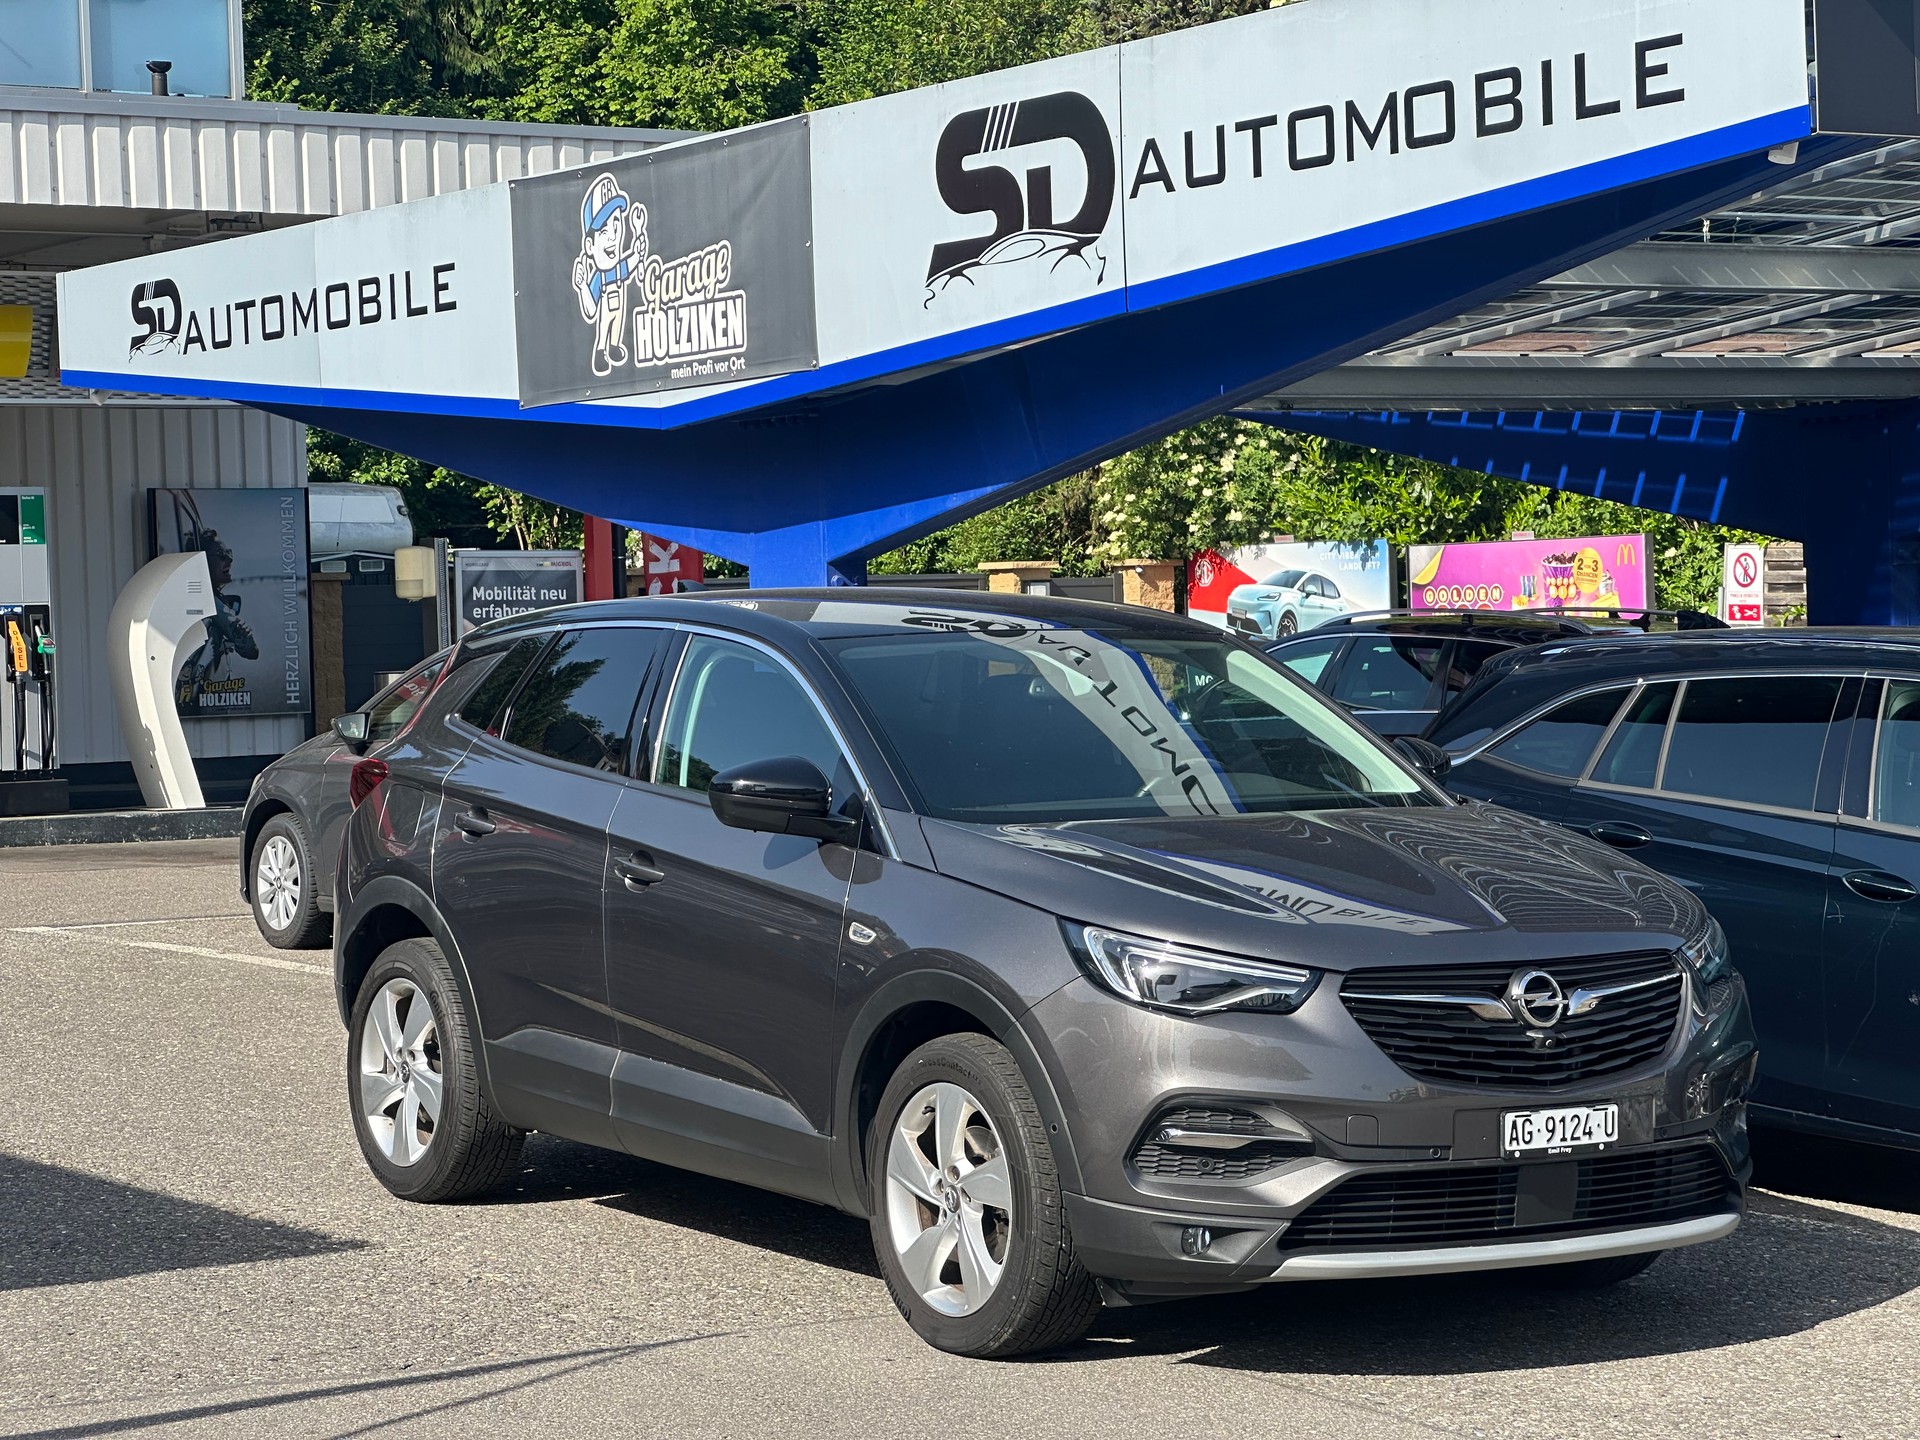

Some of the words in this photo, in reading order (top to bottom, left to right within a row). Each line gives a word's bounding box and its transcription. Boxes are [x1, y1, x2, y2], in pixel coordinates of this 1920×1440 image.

[926, 90, 1116, 287] SD
[1129, 33, 1686, 200] AUTOMOBILE
[644, 246, 730, 318] Garage
[182, 262, 458, 355] AUTOMOBILE
[636, 297, 743, 360] HOLZIKEN
[671, 364, 692, 379] mein
[692, 359, 714, 376] Profi
[714, 361, 729, 373] vor
[730, 356, 746, 371] Ort
[280, 496, 298, 615] WILLKOMMEN
[1319, 552, 1336, 561] CITY
[1577, 557, 1584, 571] 2
[1592, 559, 1599, 573] 3
[472, 586, 537, 601] Mobilität
[540, 589, 567, 601] neu
[1424, 586, 1503, 605] GOLDEN
[13, 630, 24, 668] DIESEL
[284, 621, 300, 704] HERZLICH
[200, 692, 251, 707] HOLZIKEN
[204, 678, 245, 694] Garage
